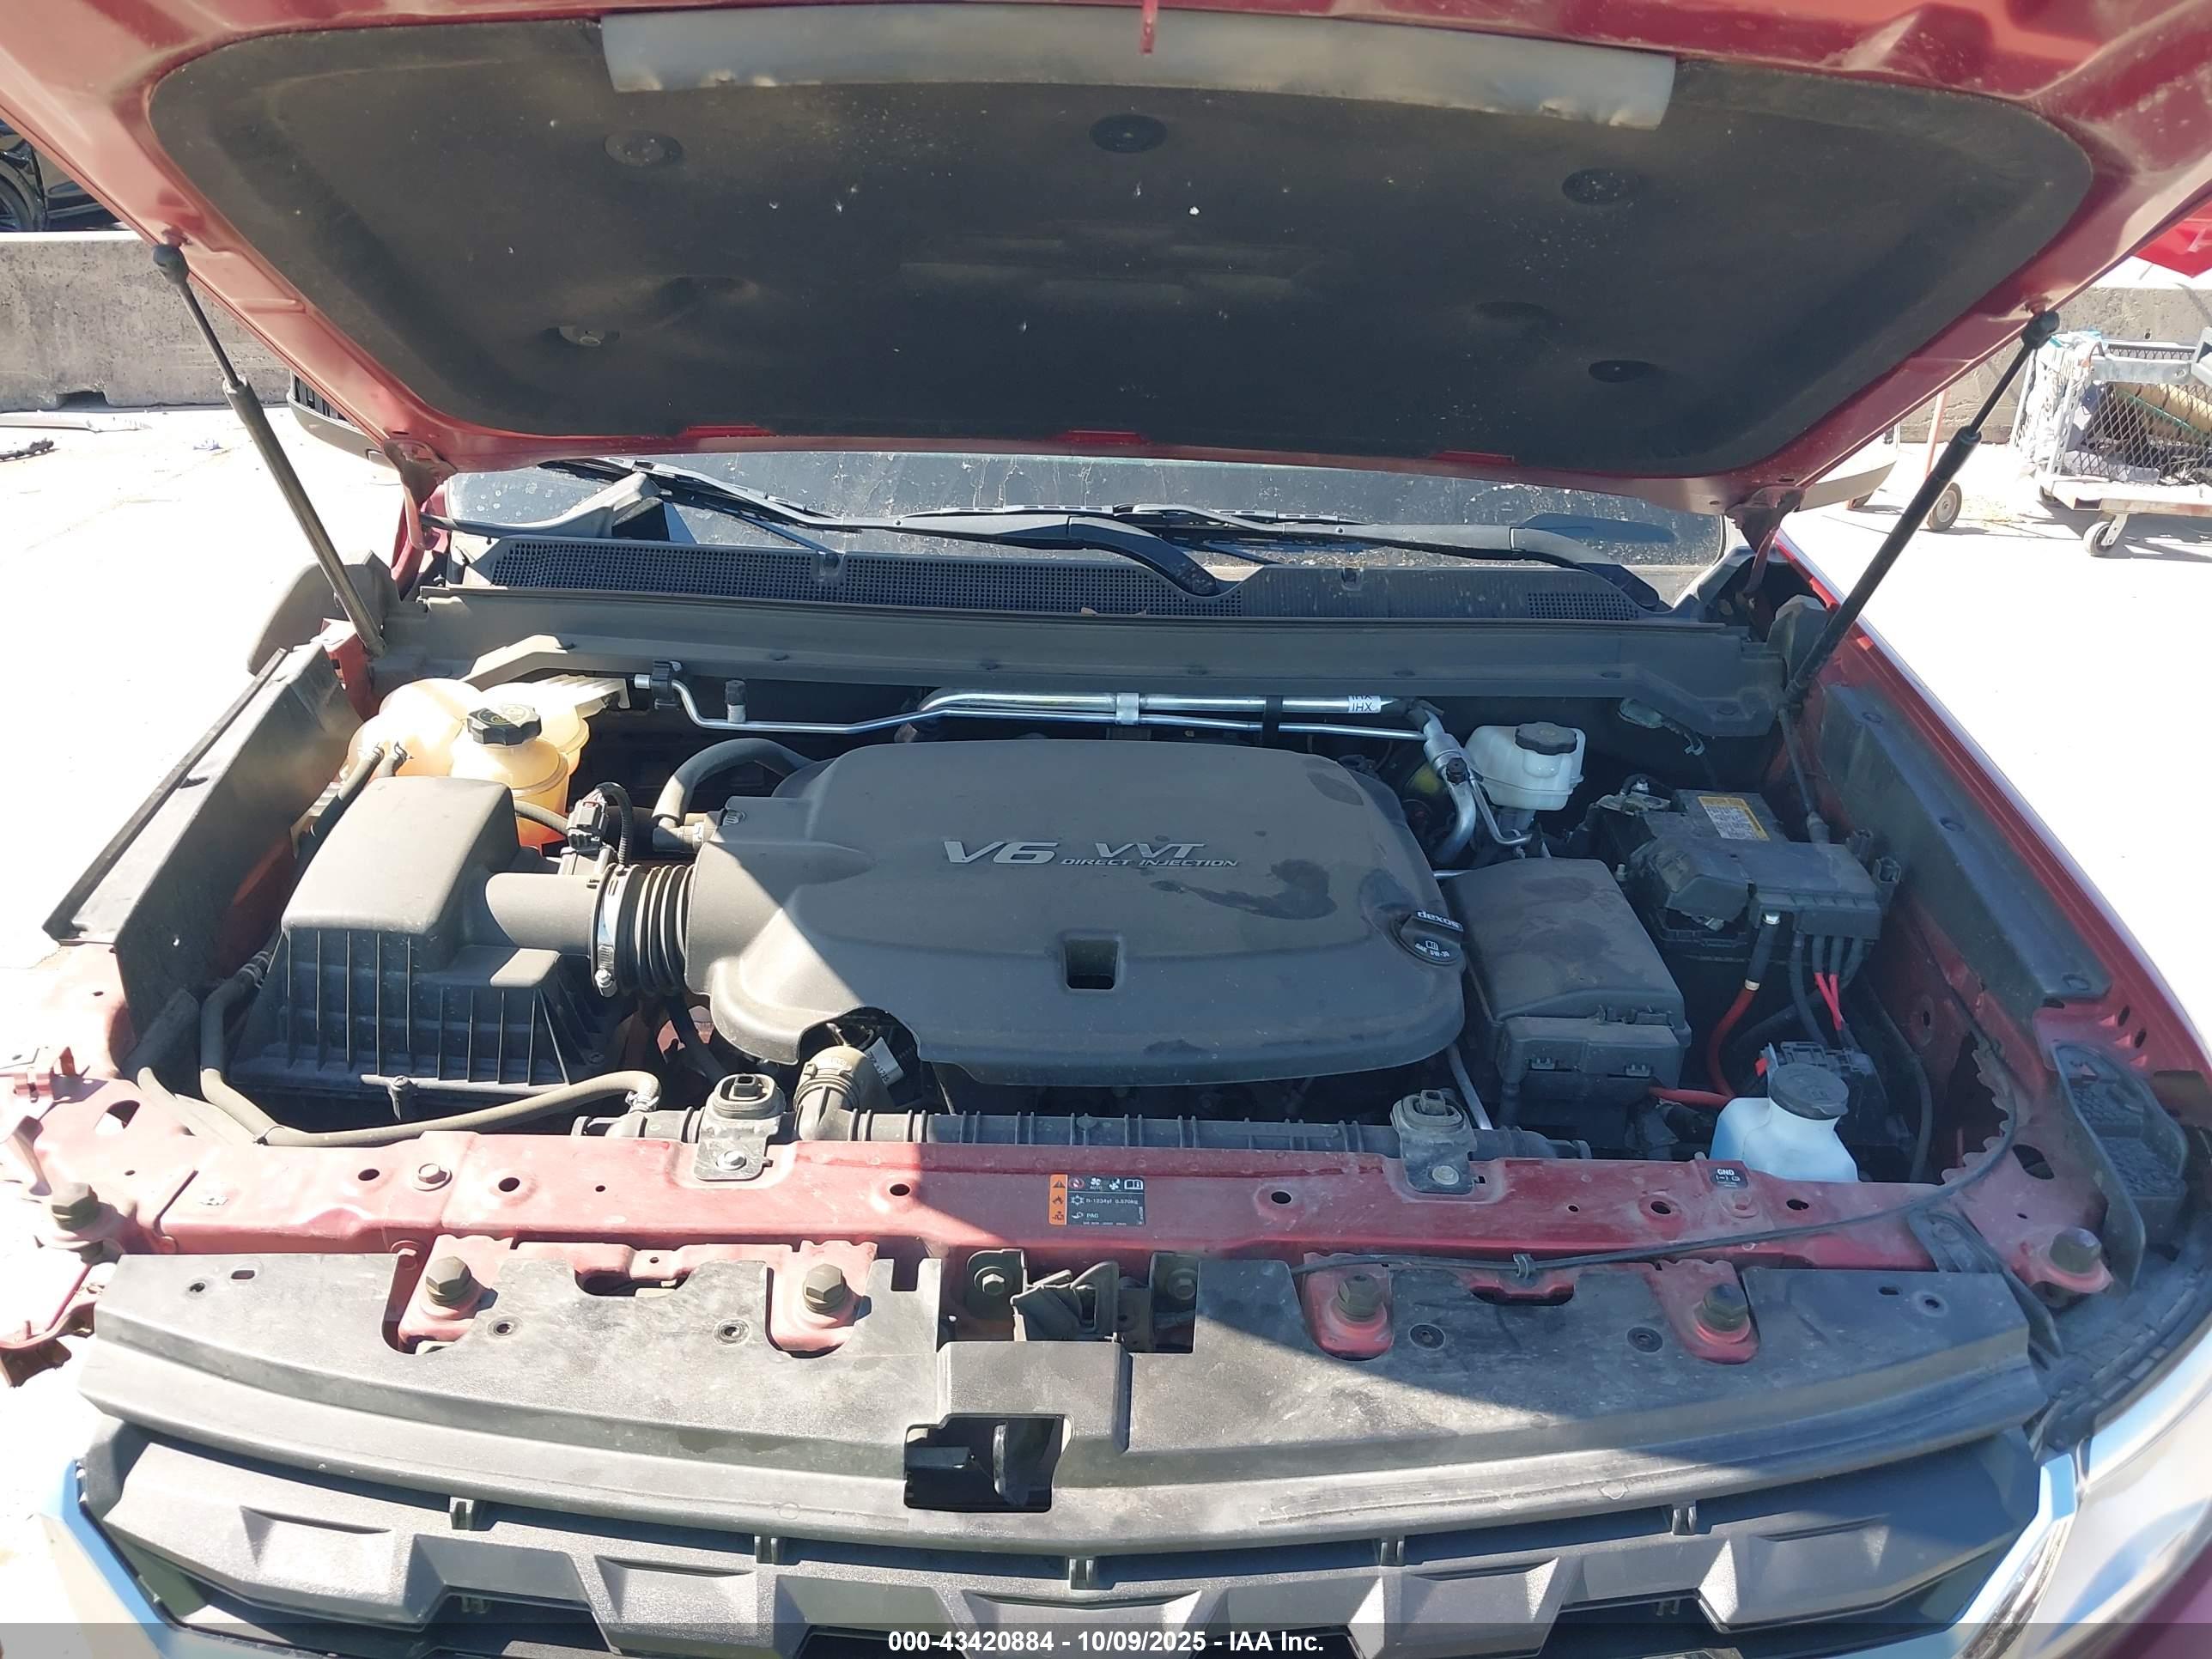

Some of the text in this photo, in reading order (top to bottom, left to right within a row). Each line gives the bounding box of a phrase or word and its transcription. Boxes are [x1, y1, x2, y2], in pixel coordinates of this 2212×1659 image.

[1352, 702, 1373, 712] IHX
[944, 841, 1206, 864] V6 VVT
[1060, 858, 1238, 867] DIRECT INJECTION
[1417, 911, 1461, 928] dexos
